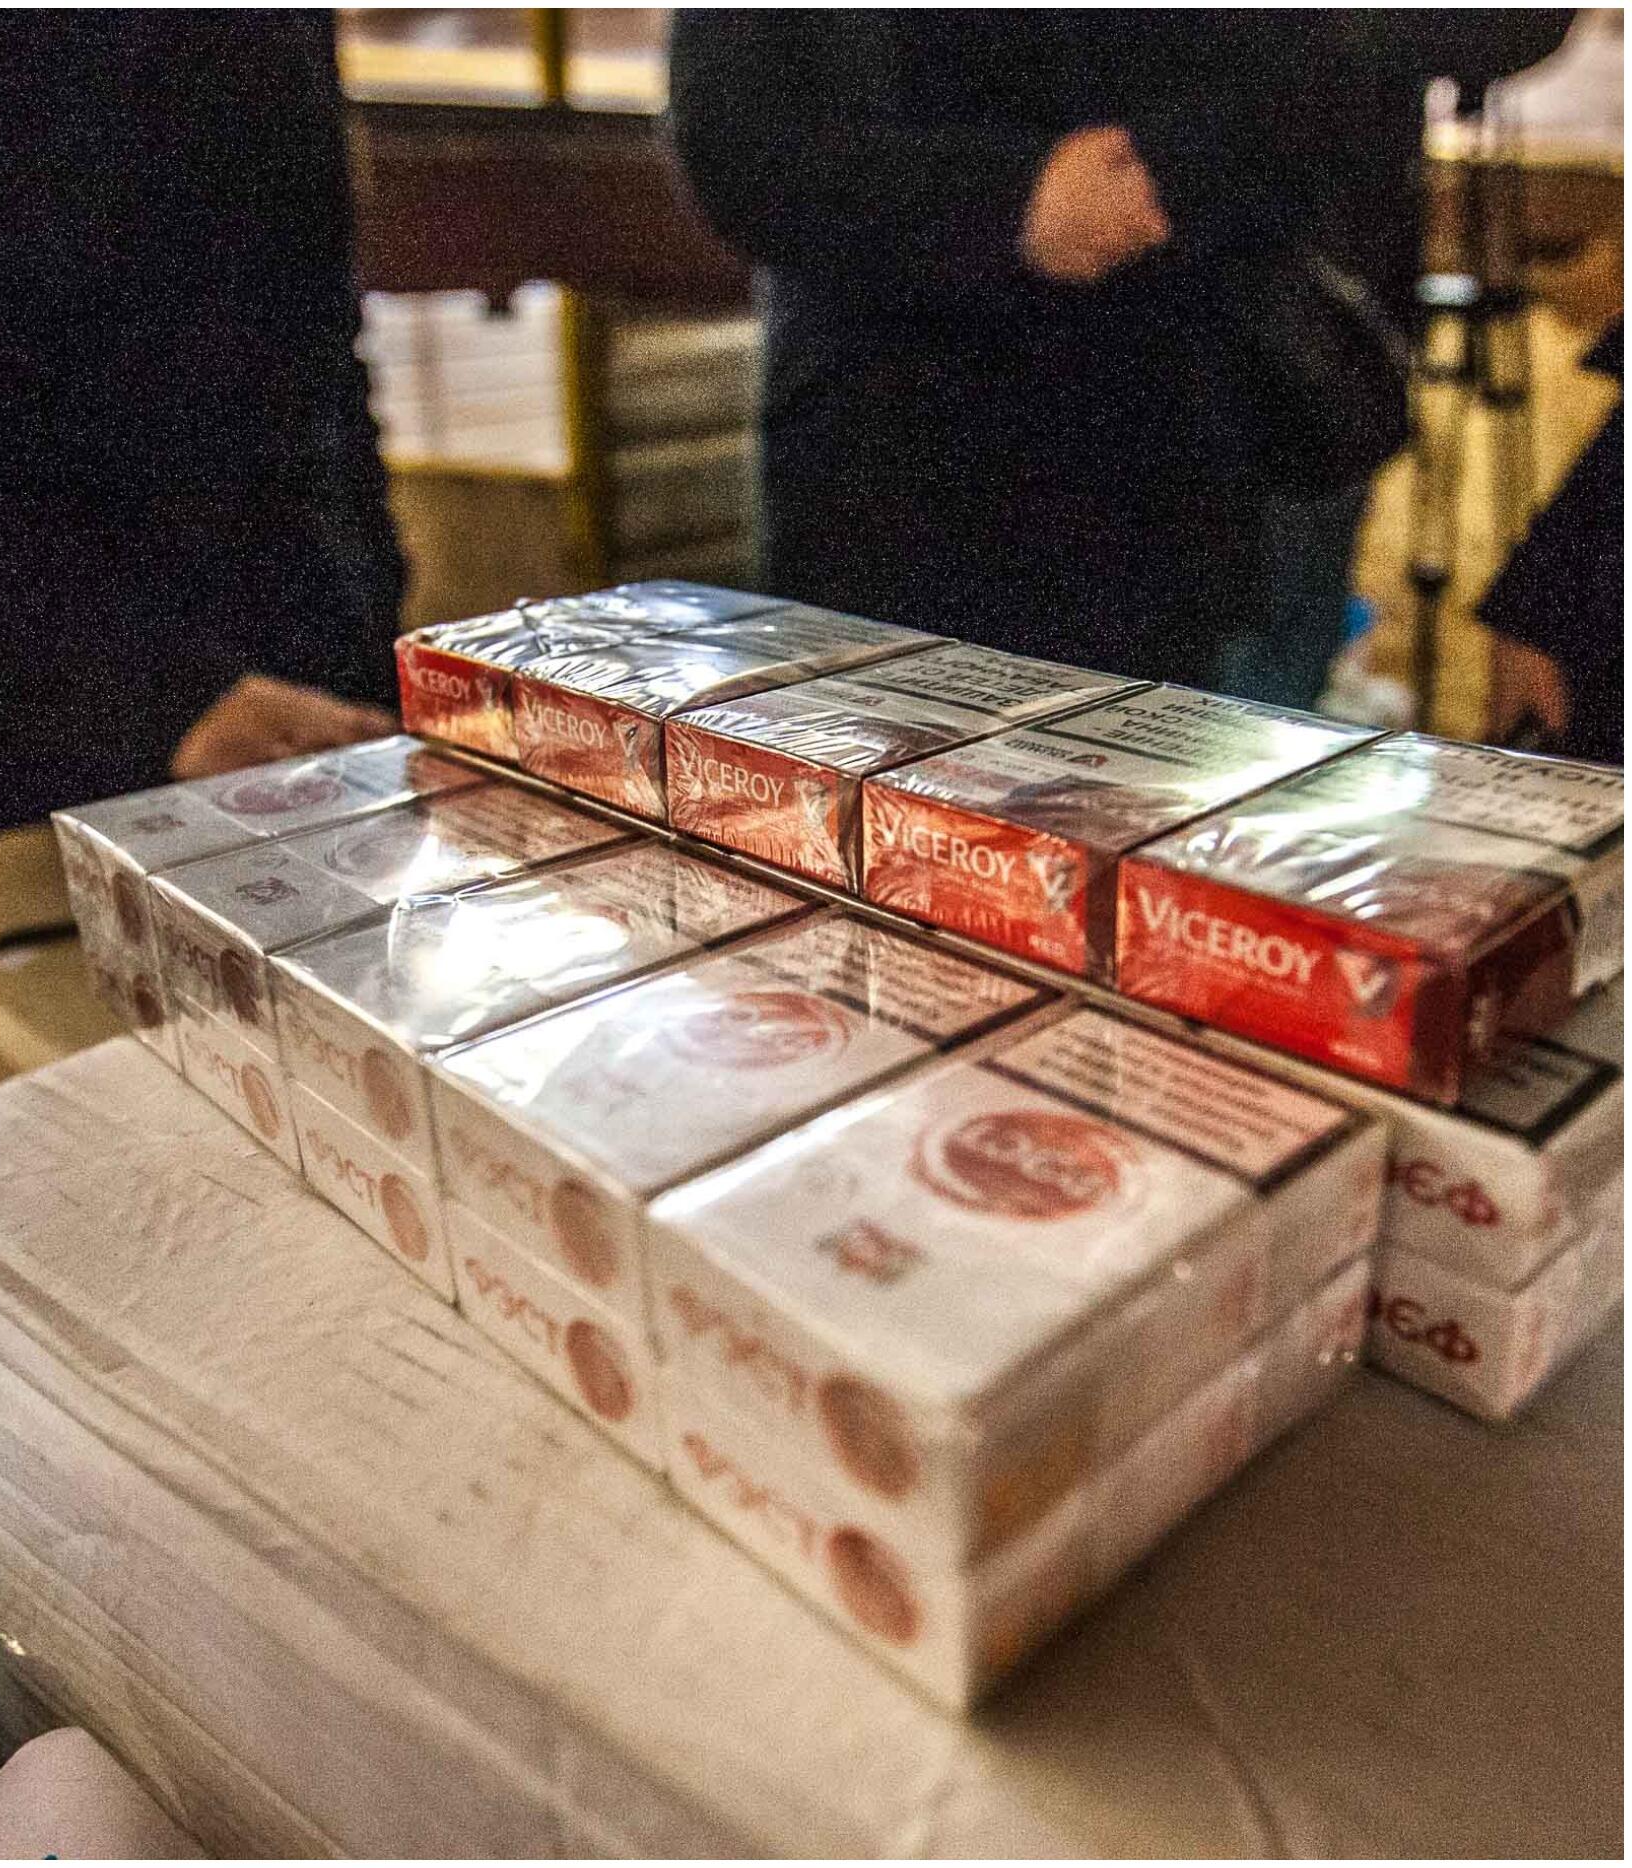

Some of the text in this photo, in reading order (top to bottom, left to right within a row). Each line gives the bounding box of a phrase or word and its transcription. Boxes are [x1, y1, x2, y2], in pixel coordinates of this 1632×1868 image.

[520, 689, 607, 748] VICEROY
[676, 742, 785, 807] VICEROY
[877, 806, 1016, 885] VICEROY
[1137, 886, 1322, 984] VICEROY
